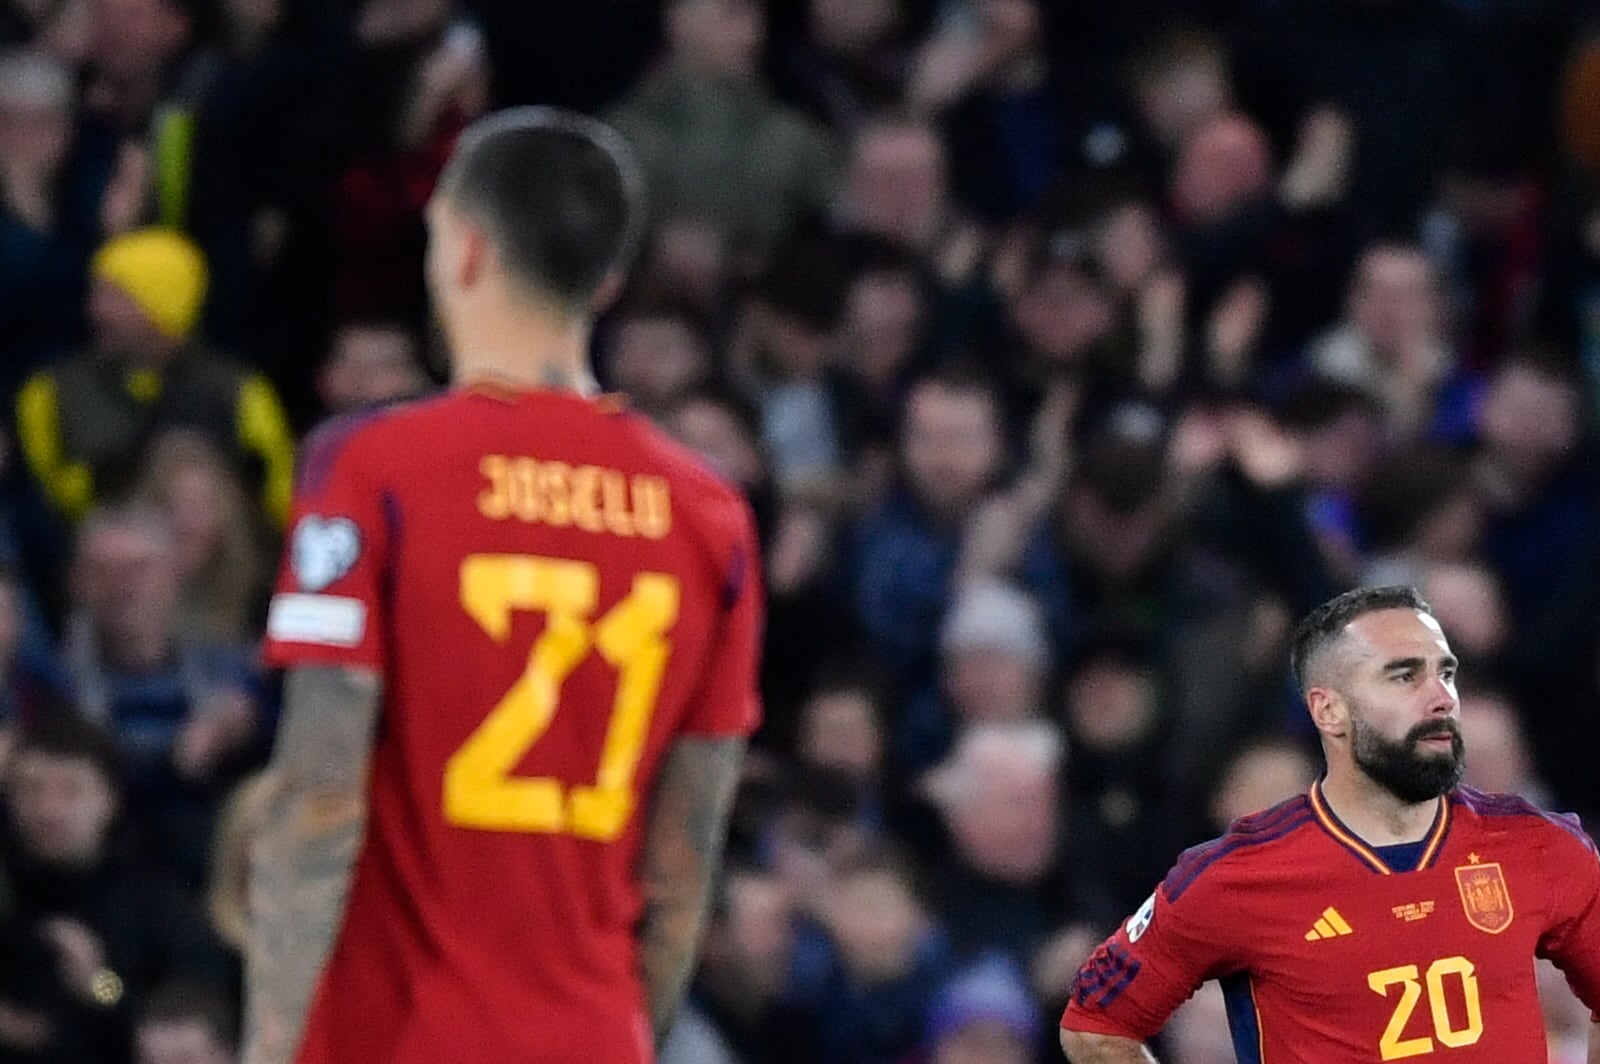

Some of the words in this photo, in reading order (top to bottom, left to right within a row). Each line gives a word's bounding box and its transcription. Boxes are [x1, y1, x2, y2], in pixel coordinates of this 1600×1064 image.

[477, 454, 672, 540] JOSELU
[441, 553, 681, 841] 21
[1367, 955, 1484, 1061] 20
